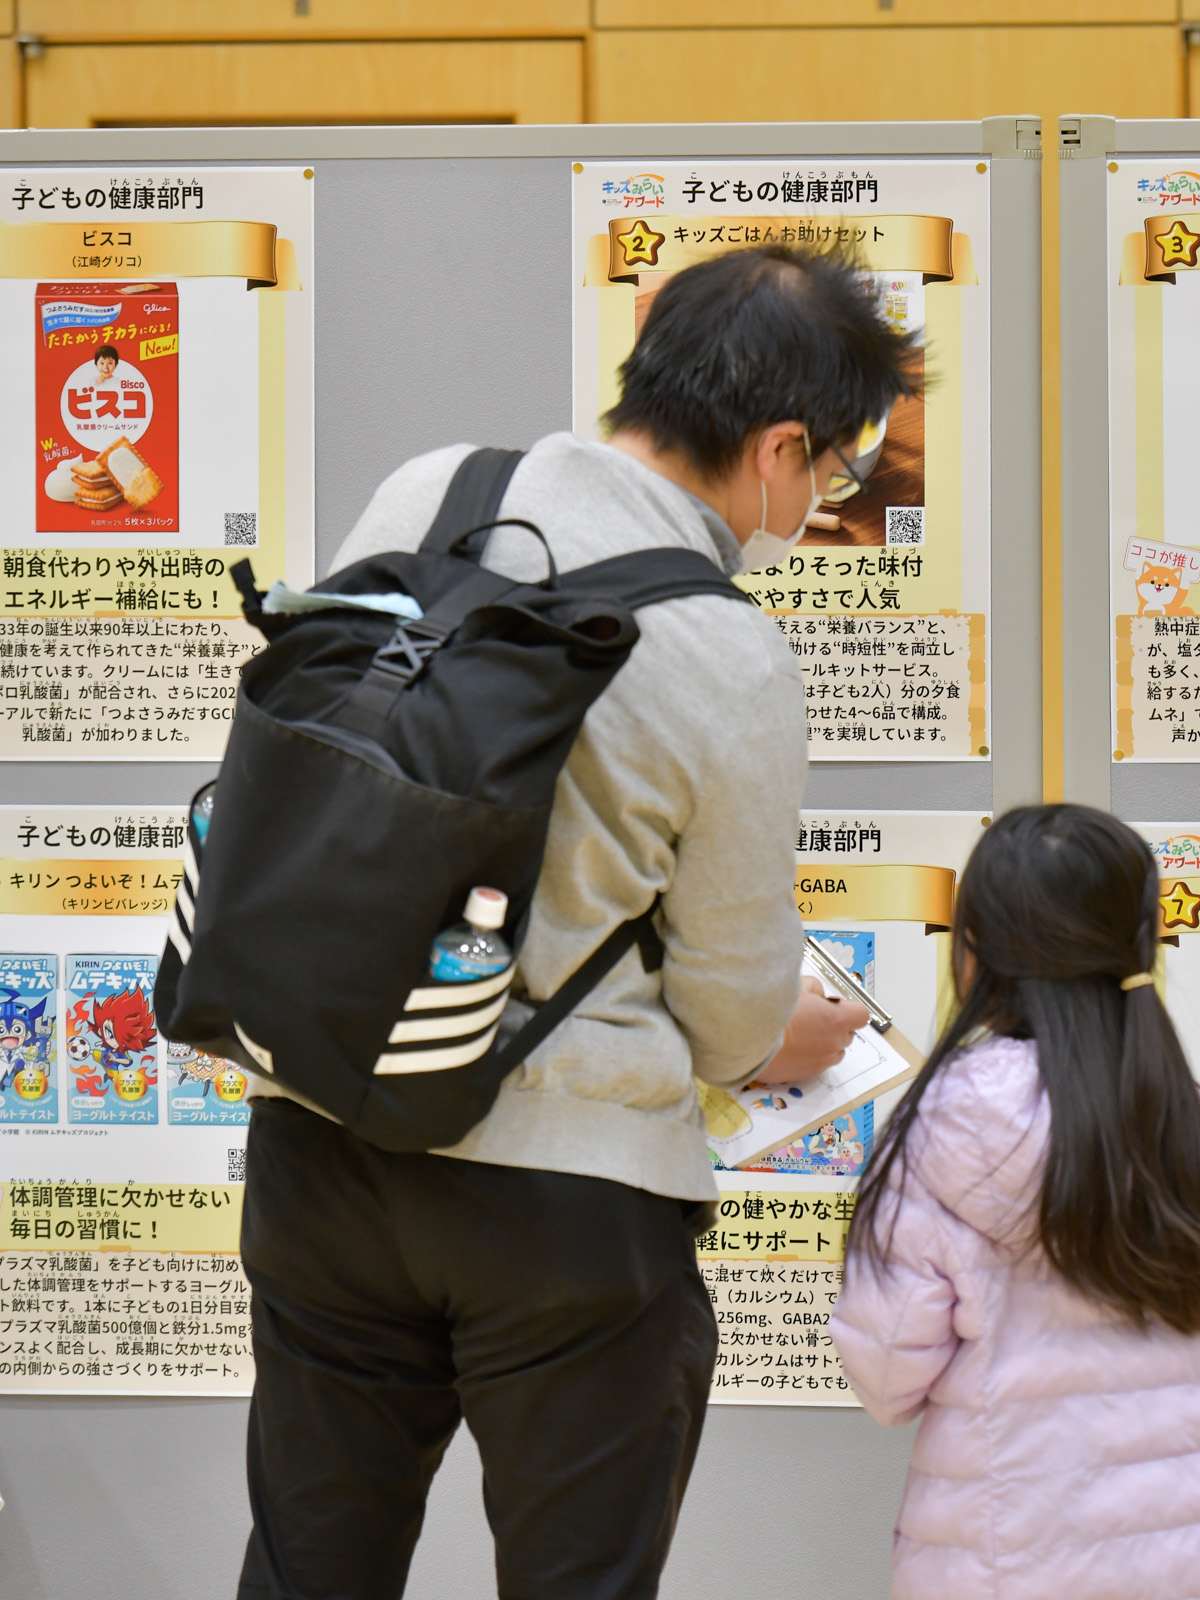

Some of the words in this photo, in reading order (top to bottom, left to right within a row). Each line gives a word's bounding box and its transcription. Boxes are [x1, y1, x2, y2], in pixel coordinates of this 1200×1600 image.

[603, 177, 663, 195] キッズみらい
[683, 179, 878, 203] 子どもの健康部門
[1138, 174, 1200, 192] キッズみらい
[12, 187, 204, 209] 子どもの健康部門
[624, 196, 664, 208] アワード
[1159, 193, 1200, 206] アワード
[83, 230, 132, 246] ビスコ
[673, 226, 884, 243] キッズごはんお助けセット
[632, 237, 645, 252] 2
[1172, 236, 1182, 252] 3
[72, 256, 143, 268] （江崎グリコ）
[143, 304, 171, 314] Glico
[146, 339, 176, 356] New!
[121, 380, 144, 389] Bisco
[68, 387, 146, 419] ビスコ
[125, 518, 173, 526] 5枚×3パック
[1131, 545, 1199, 570] ココが推し
[4, 557, 224, 578] 朝食代わりや外出時の
[744, 555, 923, 577] よりそった味付
[5, 589, 219, 610] エネルギー補給にも！
[0, 644, 270, 657] 健康を考えて作られてきた“栄養菓子”と
[0, 707, 234, 720] アルで新たに「つよさうみだすGC
[23, 728, 191, 742] 乳酸菌」が加わりました。
[17, 825, 189, 848] 子どもの健康部
[11, 874, 59, 889] キリン
[63, 899, 168, 910] （キリンビバレッジ）
[1173, 900, 1182, 914] 7
[70, 971, 155, 989] ムテキッズ
[10, 1186, 230, 1209] 体調管理に欠かせない
[721, 1199, 854, 1220] の健やかな生
[11, 1218, 158, 1240] 毎日の習慣に！
[0, 1257, 244, 1272] ラズマ乳酸菌」を子ども向けに初め
[0, 1300, 252, 1314] ト飲料です。1本に子どもの1日分目安
[0, 1362, 240, 1376] の内側からの強さづくりをサポート。
[710, 1375, 848, 1389] ルギーの子どもでも
